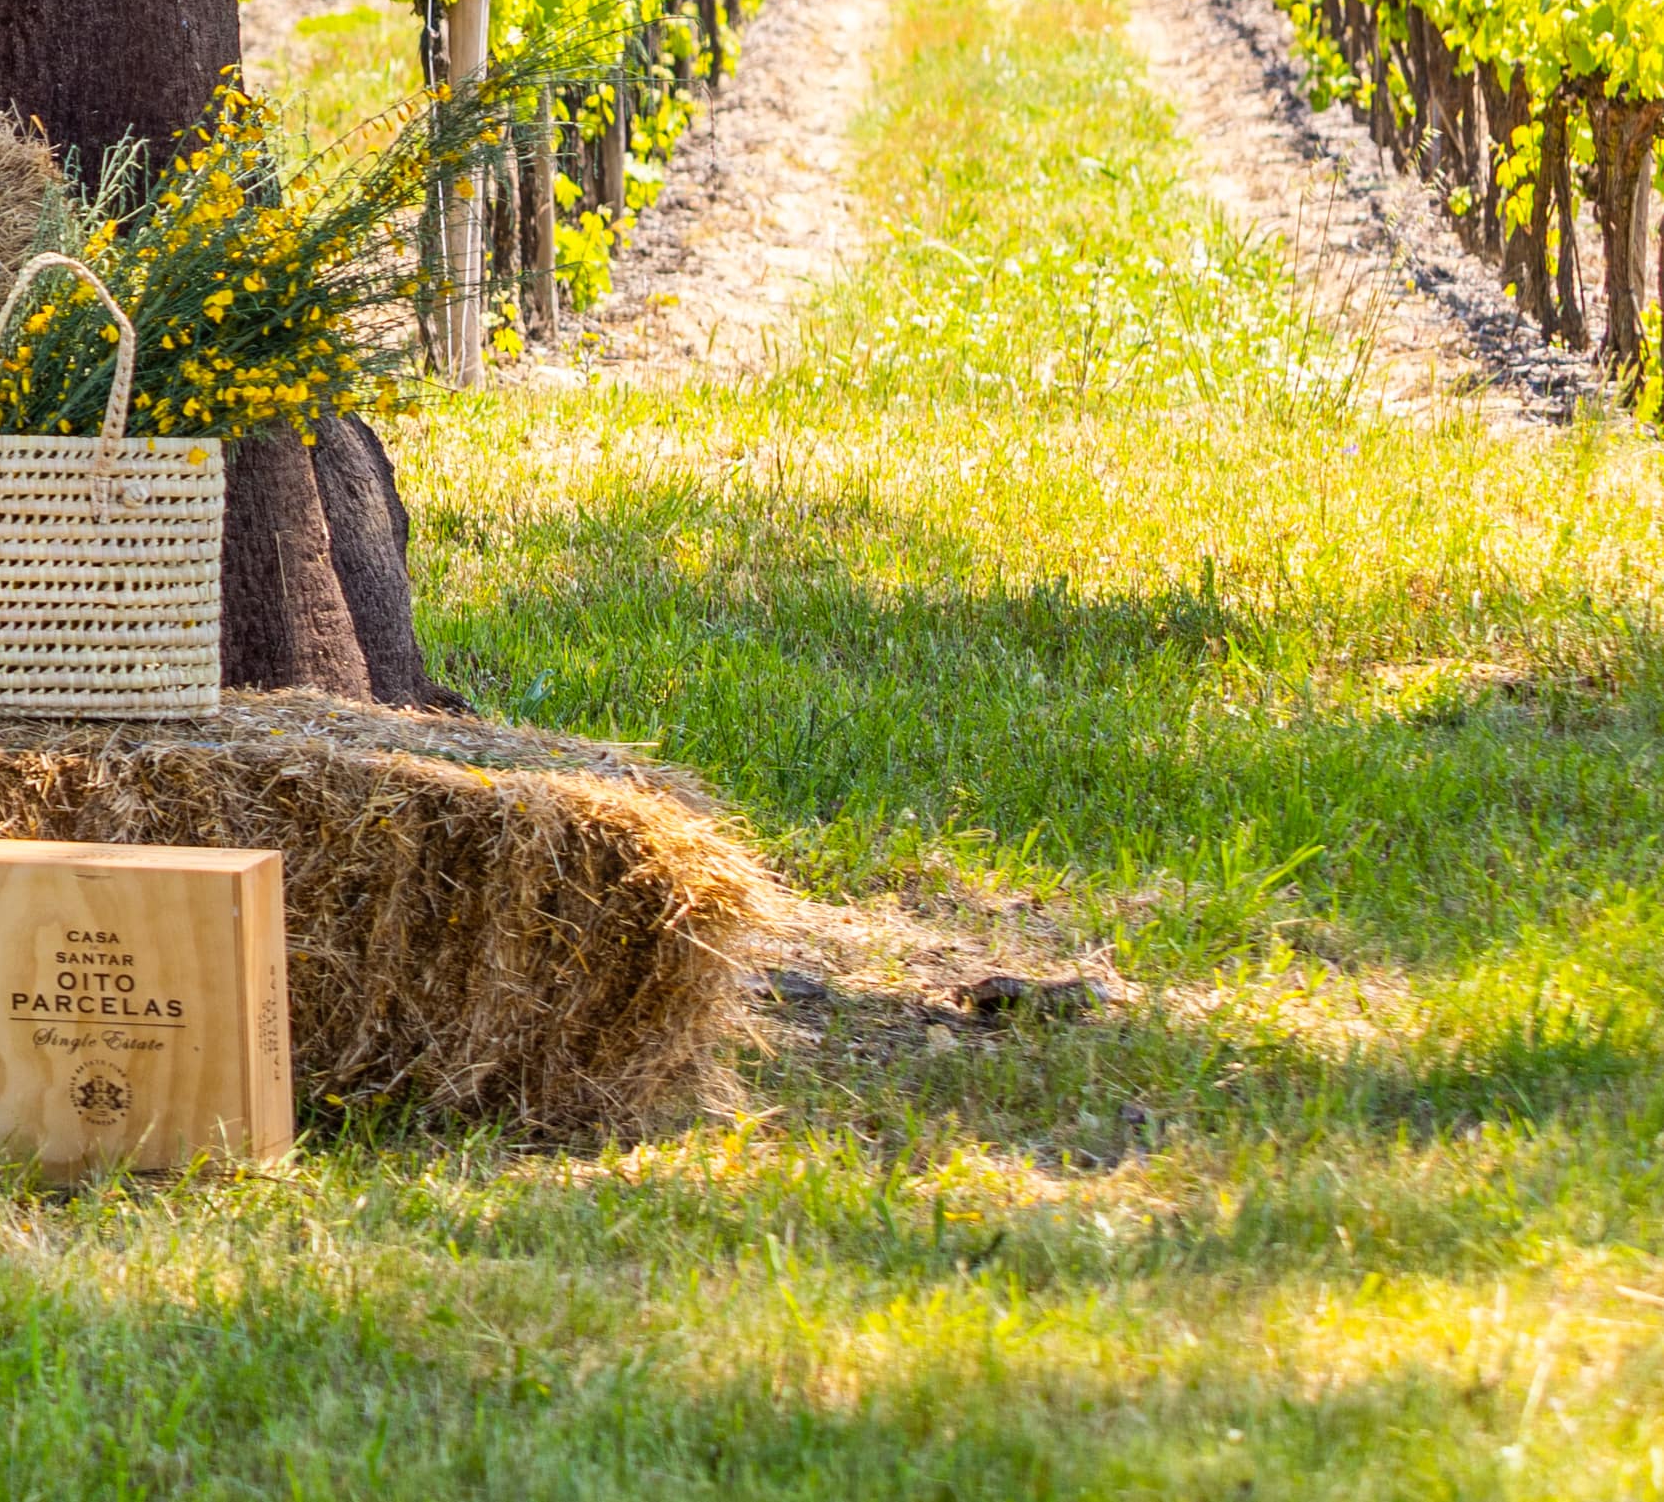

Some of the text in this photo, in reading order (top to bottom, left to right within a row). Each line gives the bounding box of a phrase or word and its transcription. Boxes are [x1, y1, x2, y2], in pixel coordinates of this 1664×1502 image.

[66, 930, 120, 944] CASA
[56, 951, 134, 966] SANTAR
[57, 971, 135, 993] OITO
[11, 993, 183, 1018] PARCELAS
[32, 1027, 165, 1055] Single Estate
